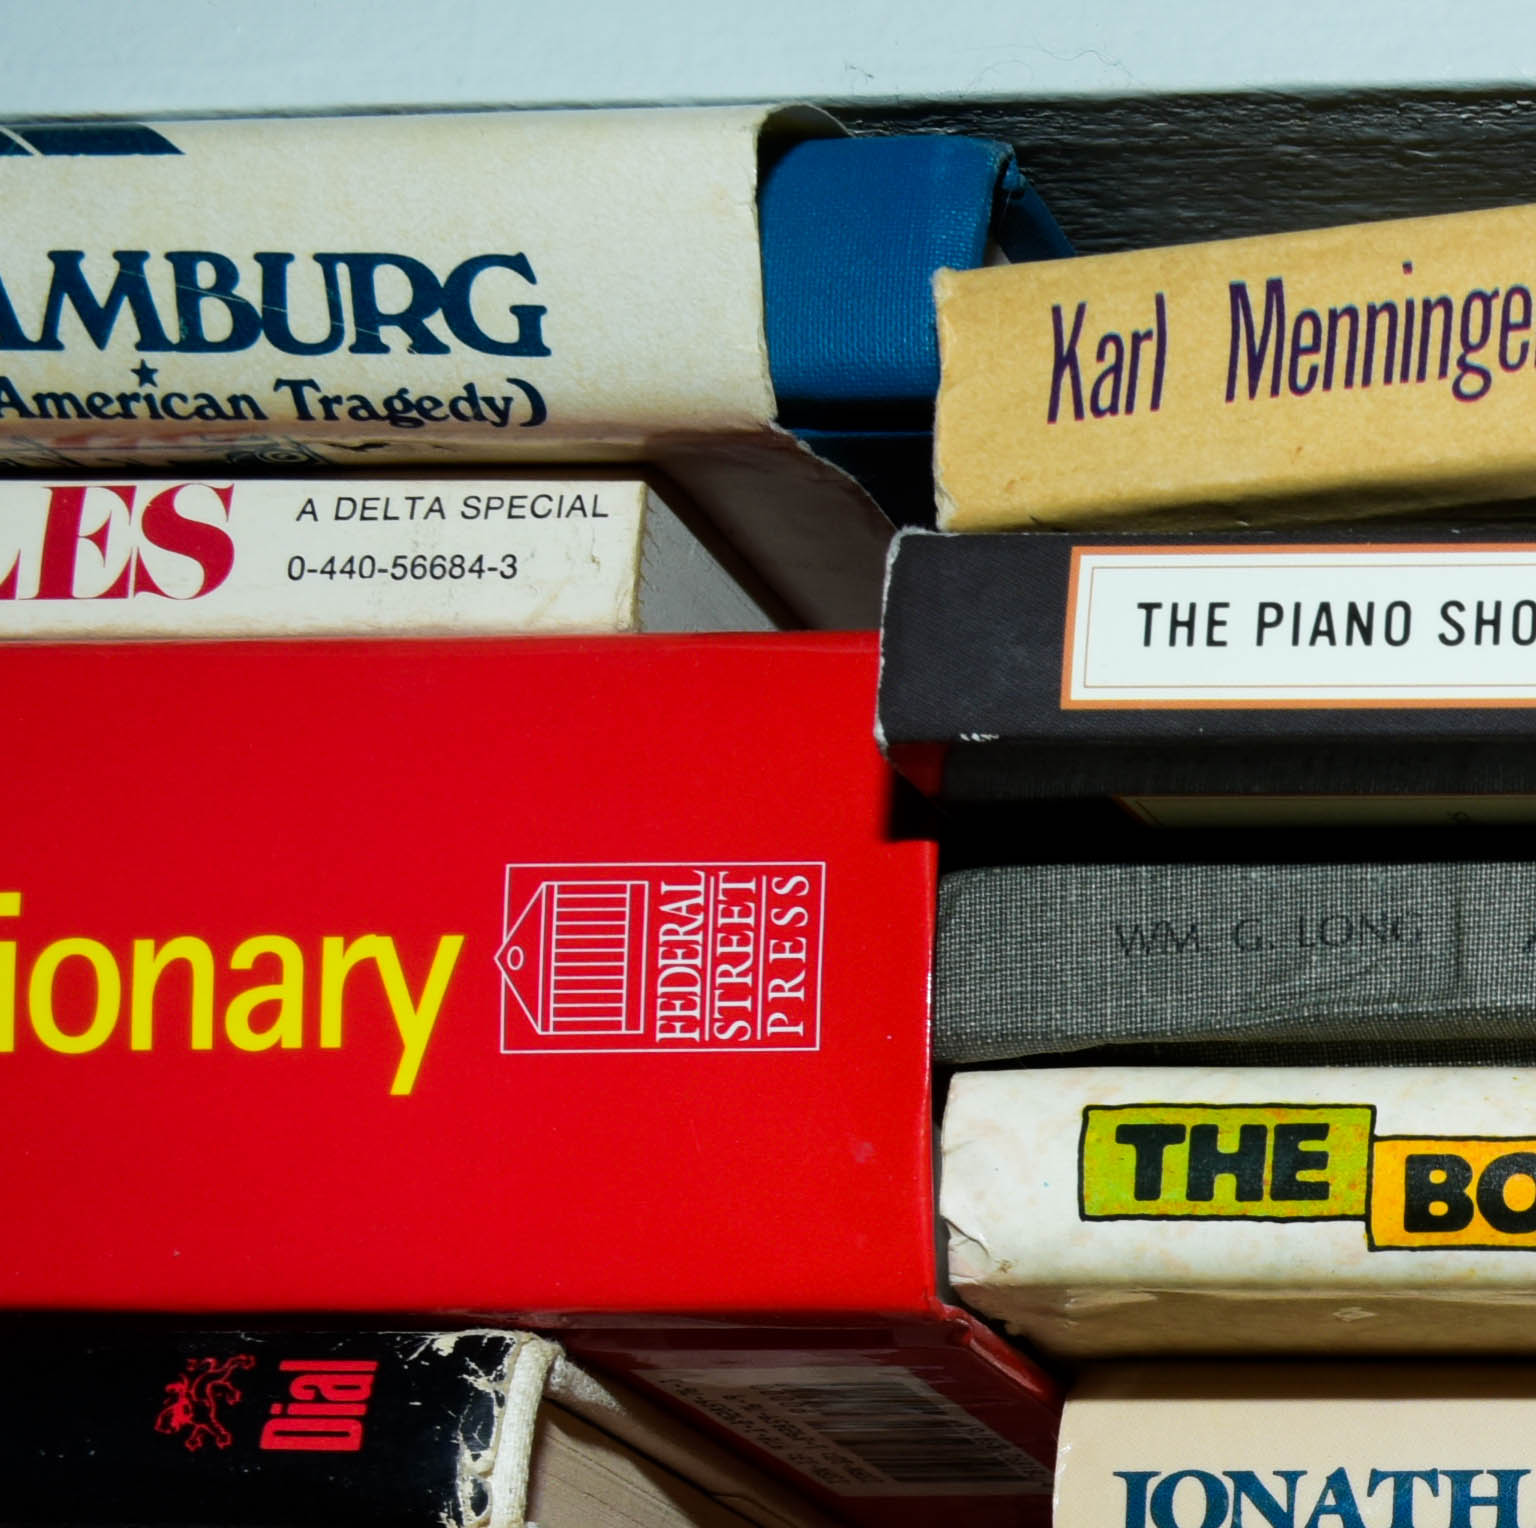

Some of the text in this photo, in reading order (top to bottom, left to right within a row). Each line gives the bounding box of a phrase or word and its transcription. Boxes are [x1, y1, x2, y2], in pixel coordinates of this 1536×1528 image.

[0, 360, 548, 429] American Tragedy)
[1047, 293, 1169, 424] Karl
[296, 494, 609, 521] A DELTA SPECIAL
[287, 553, 519, 581] 0-440-56684-3
[1137, 601, 1229, 647] THE
[1256, 600, 1412, 647] PIANO
[656, 870, 707, 1043] FEDERAL
[714, 872, 757, 1041] STREET
[766, 875, 811, 1037] PRESS
[1115, 1122, 1329, 1201] THE
[259, 1359, 379, 1452] Dial
